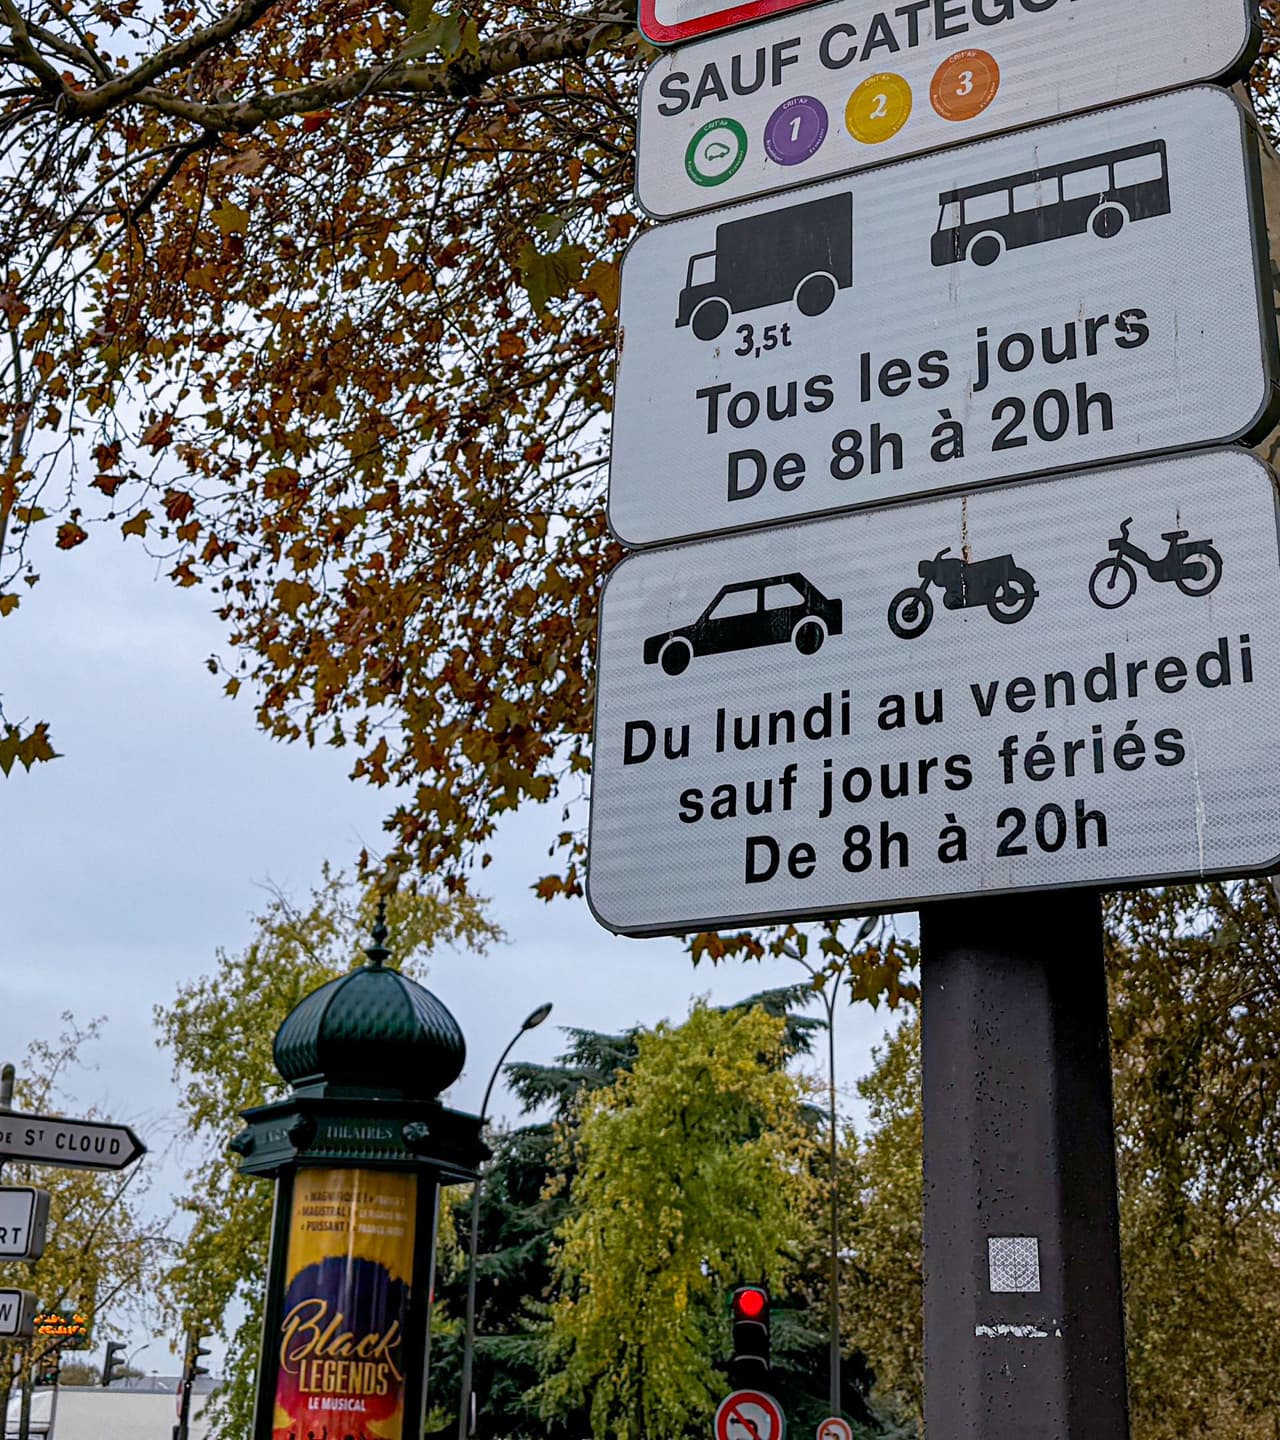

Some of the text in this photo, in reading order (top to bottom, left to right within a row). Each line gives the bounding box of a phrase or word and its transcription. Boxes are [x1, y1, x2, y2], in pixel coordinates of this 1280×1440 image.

[658, 37, 801, 116] SAUF
[955, 70, 974, 97] 3
[789, 116, 801, 142] 1
[869, 93, 888, 120] 2
[734, 322, 792, 359] 3,5t
[696, 306, 1150, 435] Tous les jours
[727, 381, 1115, 501] De 8h à 20h
[623, 633, 1255, 765] Du lundi au vendredi
[678, 719, 1187, 824] sauf jours fériés
[745, 798, 1110, 884] De 8h à 20h
[24, 1129, 45, 1147] ST
[56, 1132, 121, 1156] CLOUD
[280, 1298, 405, 1381] Black
[299, 1359, 389, 1396] LEGENDS
[308, 1397, 367, 1411] LE MUSICAL
